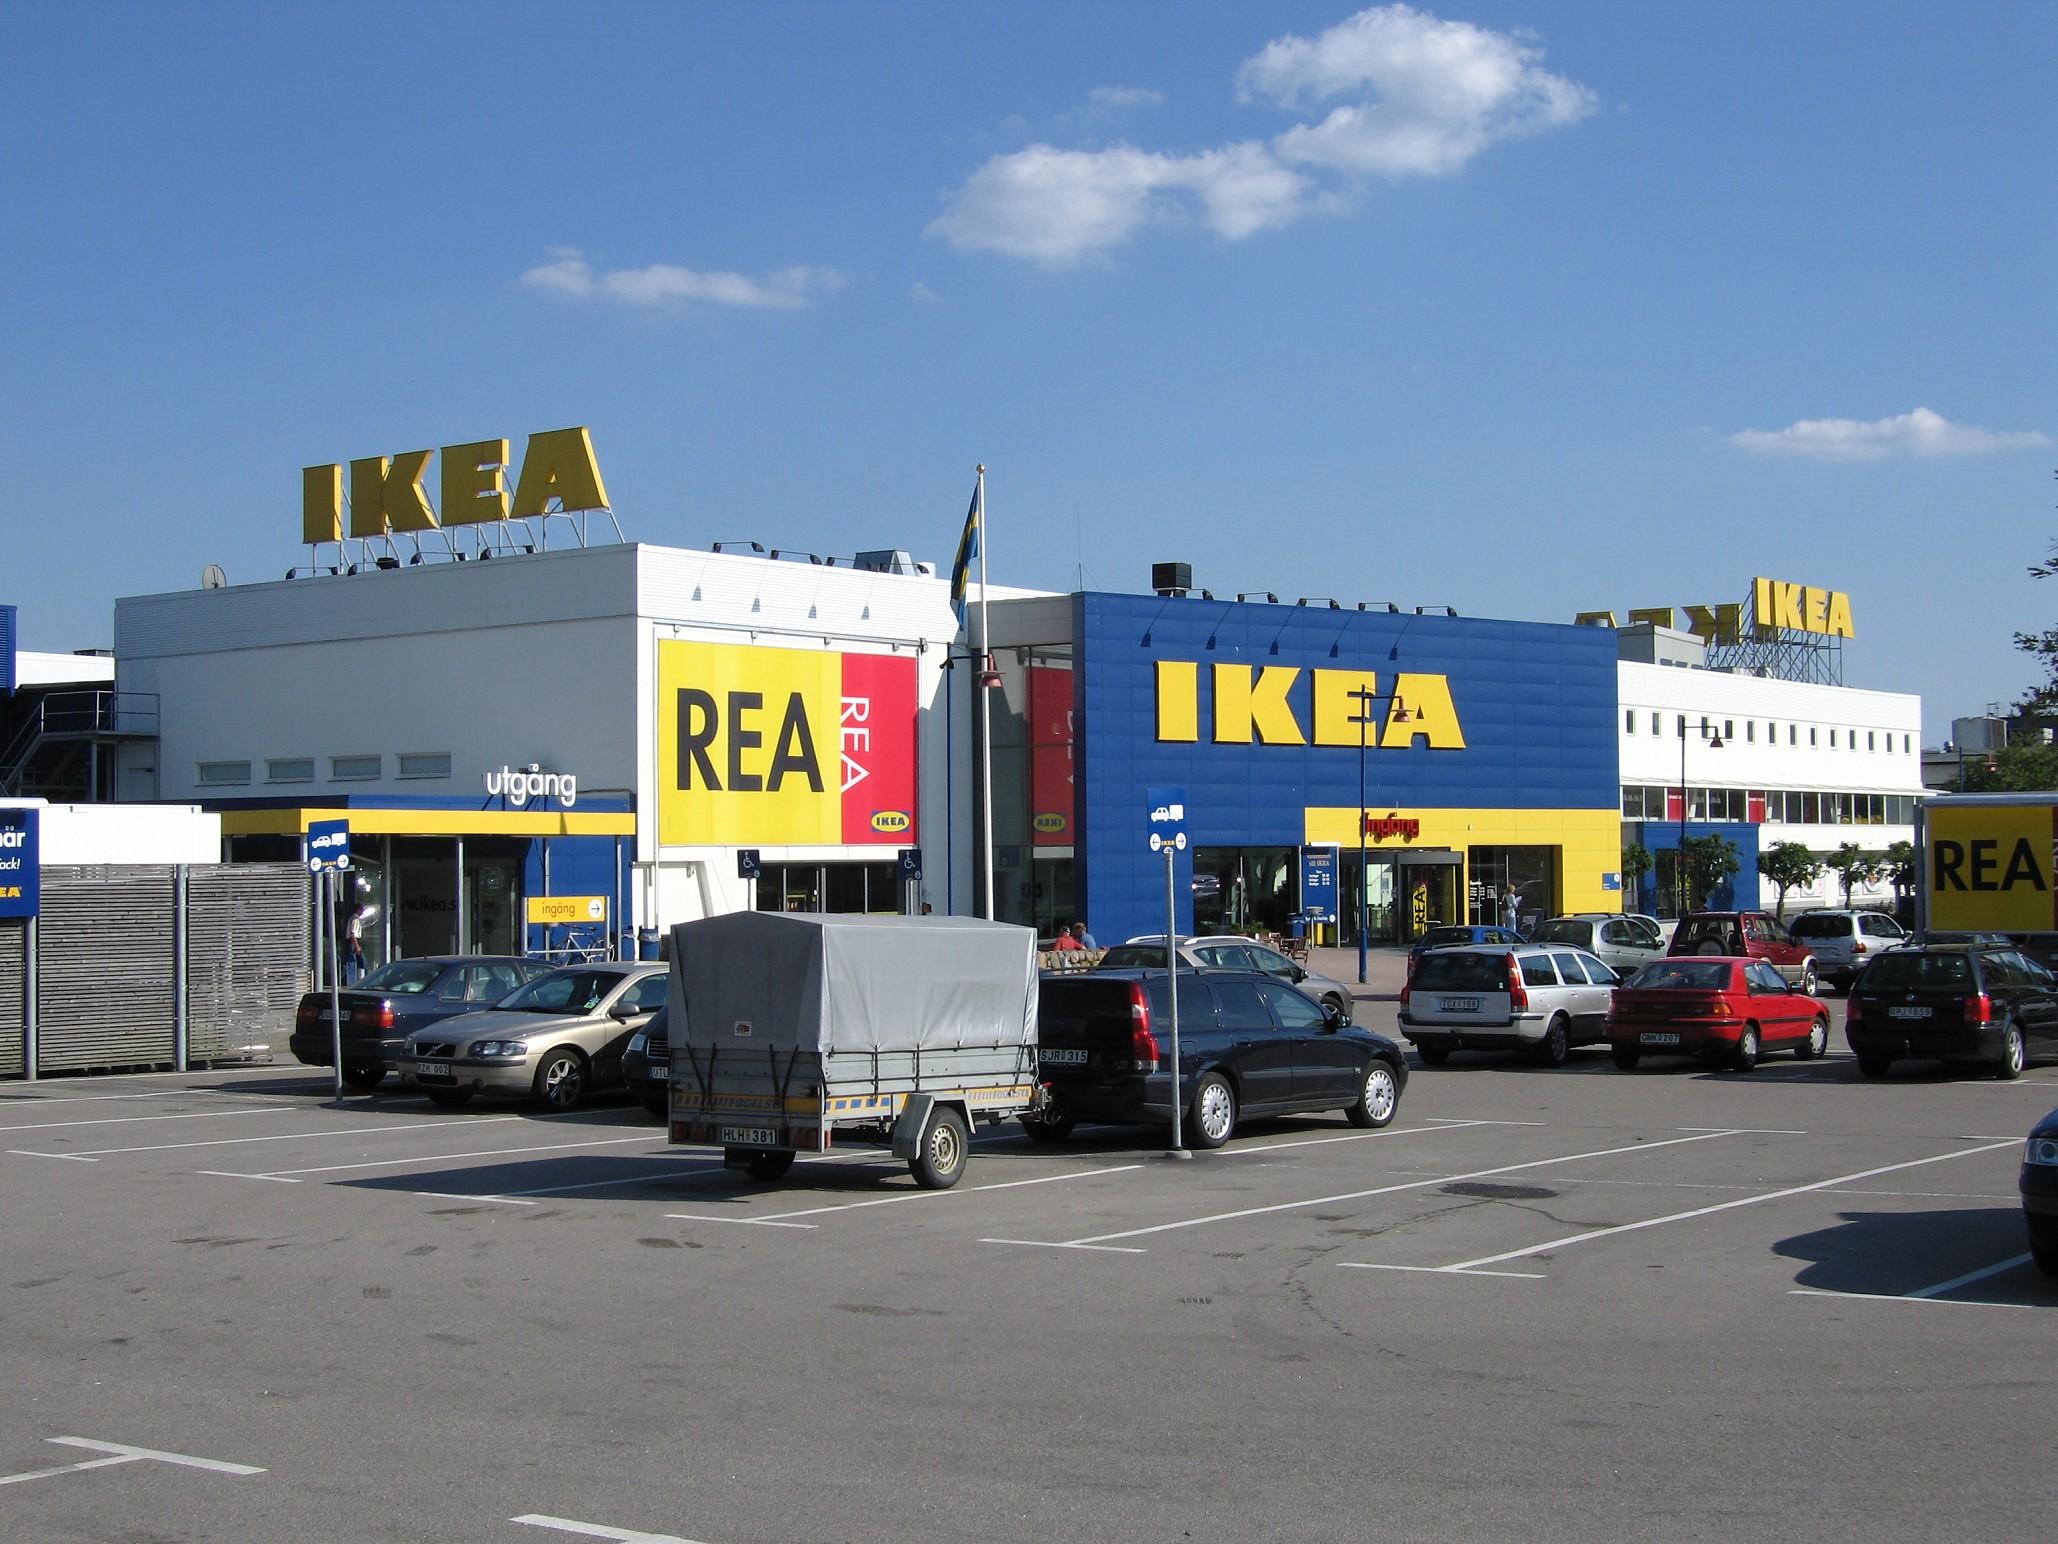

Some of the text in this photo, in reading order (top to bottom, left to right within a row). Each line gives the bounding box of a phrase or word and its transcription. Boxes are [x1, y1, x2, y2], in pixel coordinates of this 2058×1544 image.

[302, 427, 610, 544] IKEA
[1752, 576, 1856, 640] IKEA
[1153, 660, 1467, 750] IKEA
[676, 687, 825, 793] REA
[840, 696, 871, 794] REA
[486, 763, 577, 808] utgång
[0, 825, 26, 848] är
[876, 816, 906, 827] IKEA
[0, 856, 21, 870] ack!
[1933, 837, 2048, 892] REA
[541, 902, 576, 918] ingång
[1413, 889, 1427, 925] REA
[433, 1063, 449, 1074] 002
[1041, 1050, 1088, 1062] SJR 315
[723, 1128, 775, 1143] HLH 381
